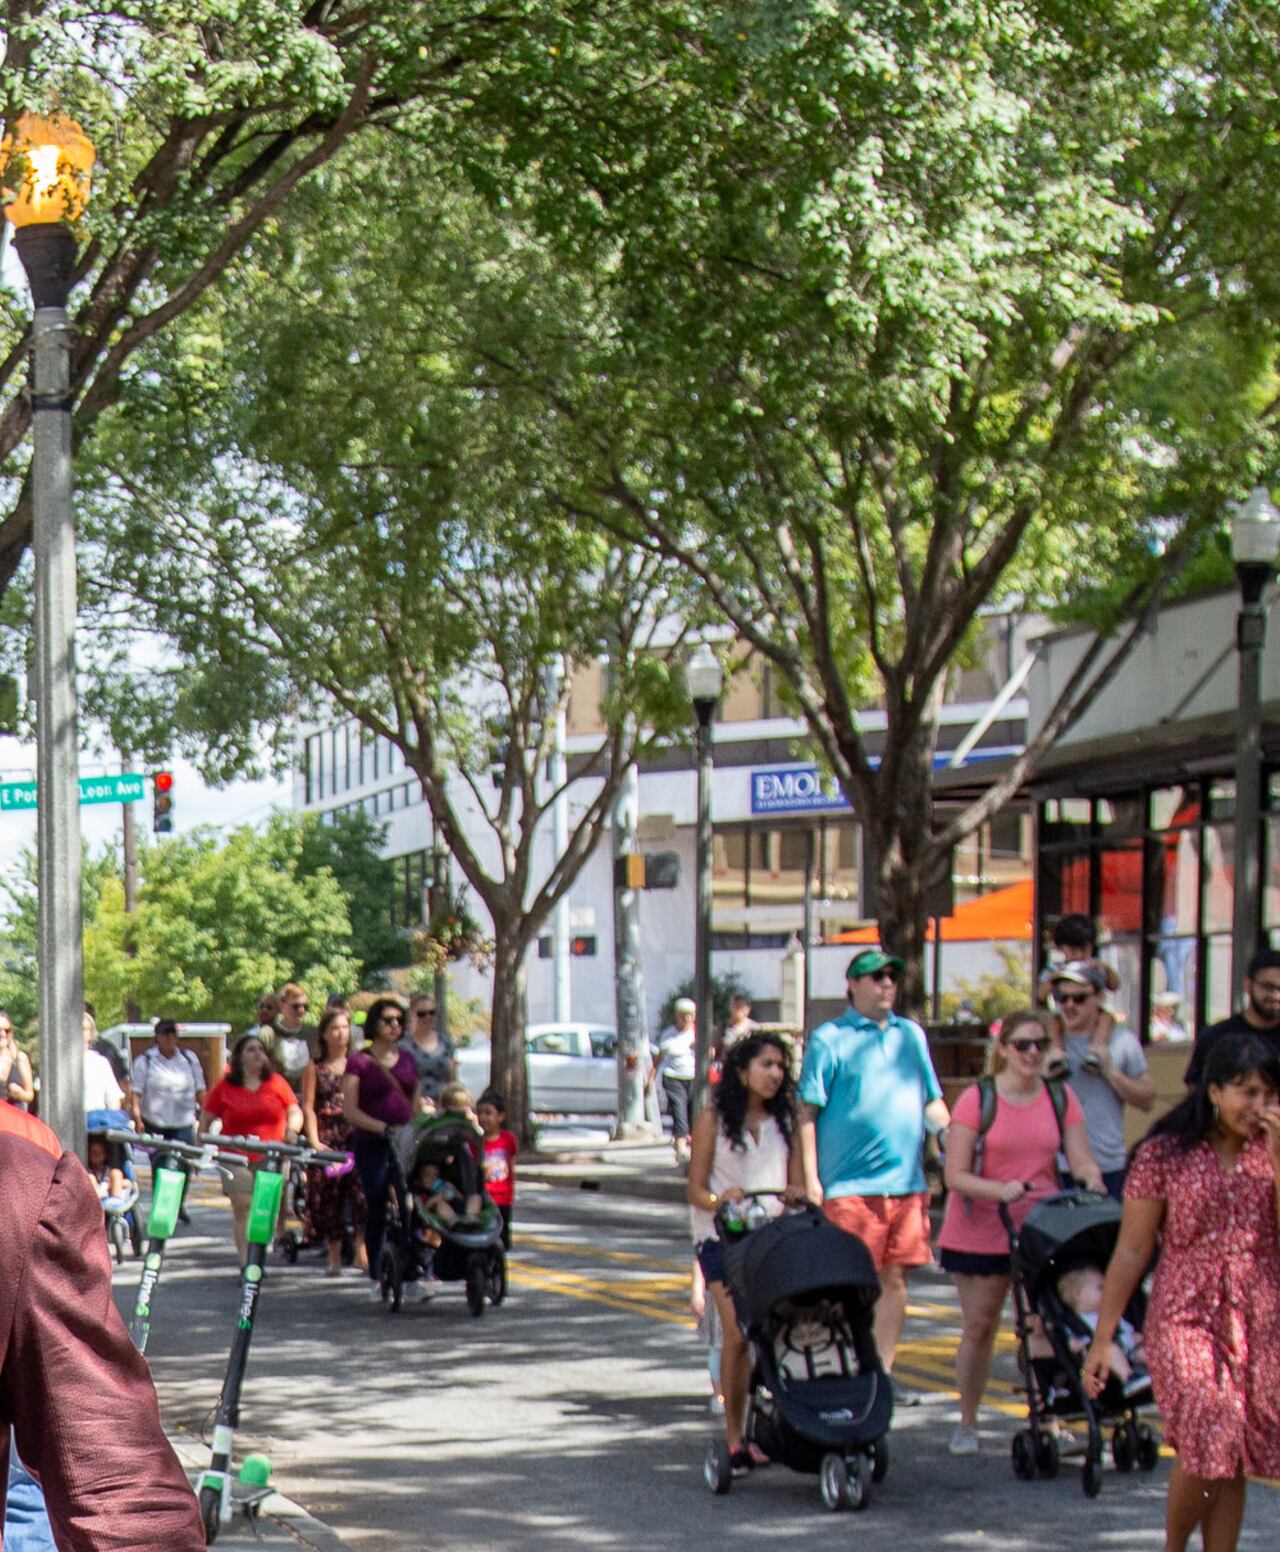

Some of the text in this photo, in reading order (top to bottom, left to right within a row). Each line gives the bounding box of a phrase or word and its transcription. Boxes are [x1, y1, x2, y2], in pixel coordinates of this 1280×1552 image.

[3, 788, 12, 805] E
[78, 783, 112, 800] Leon
[116, 779, 141, 796] Ave
